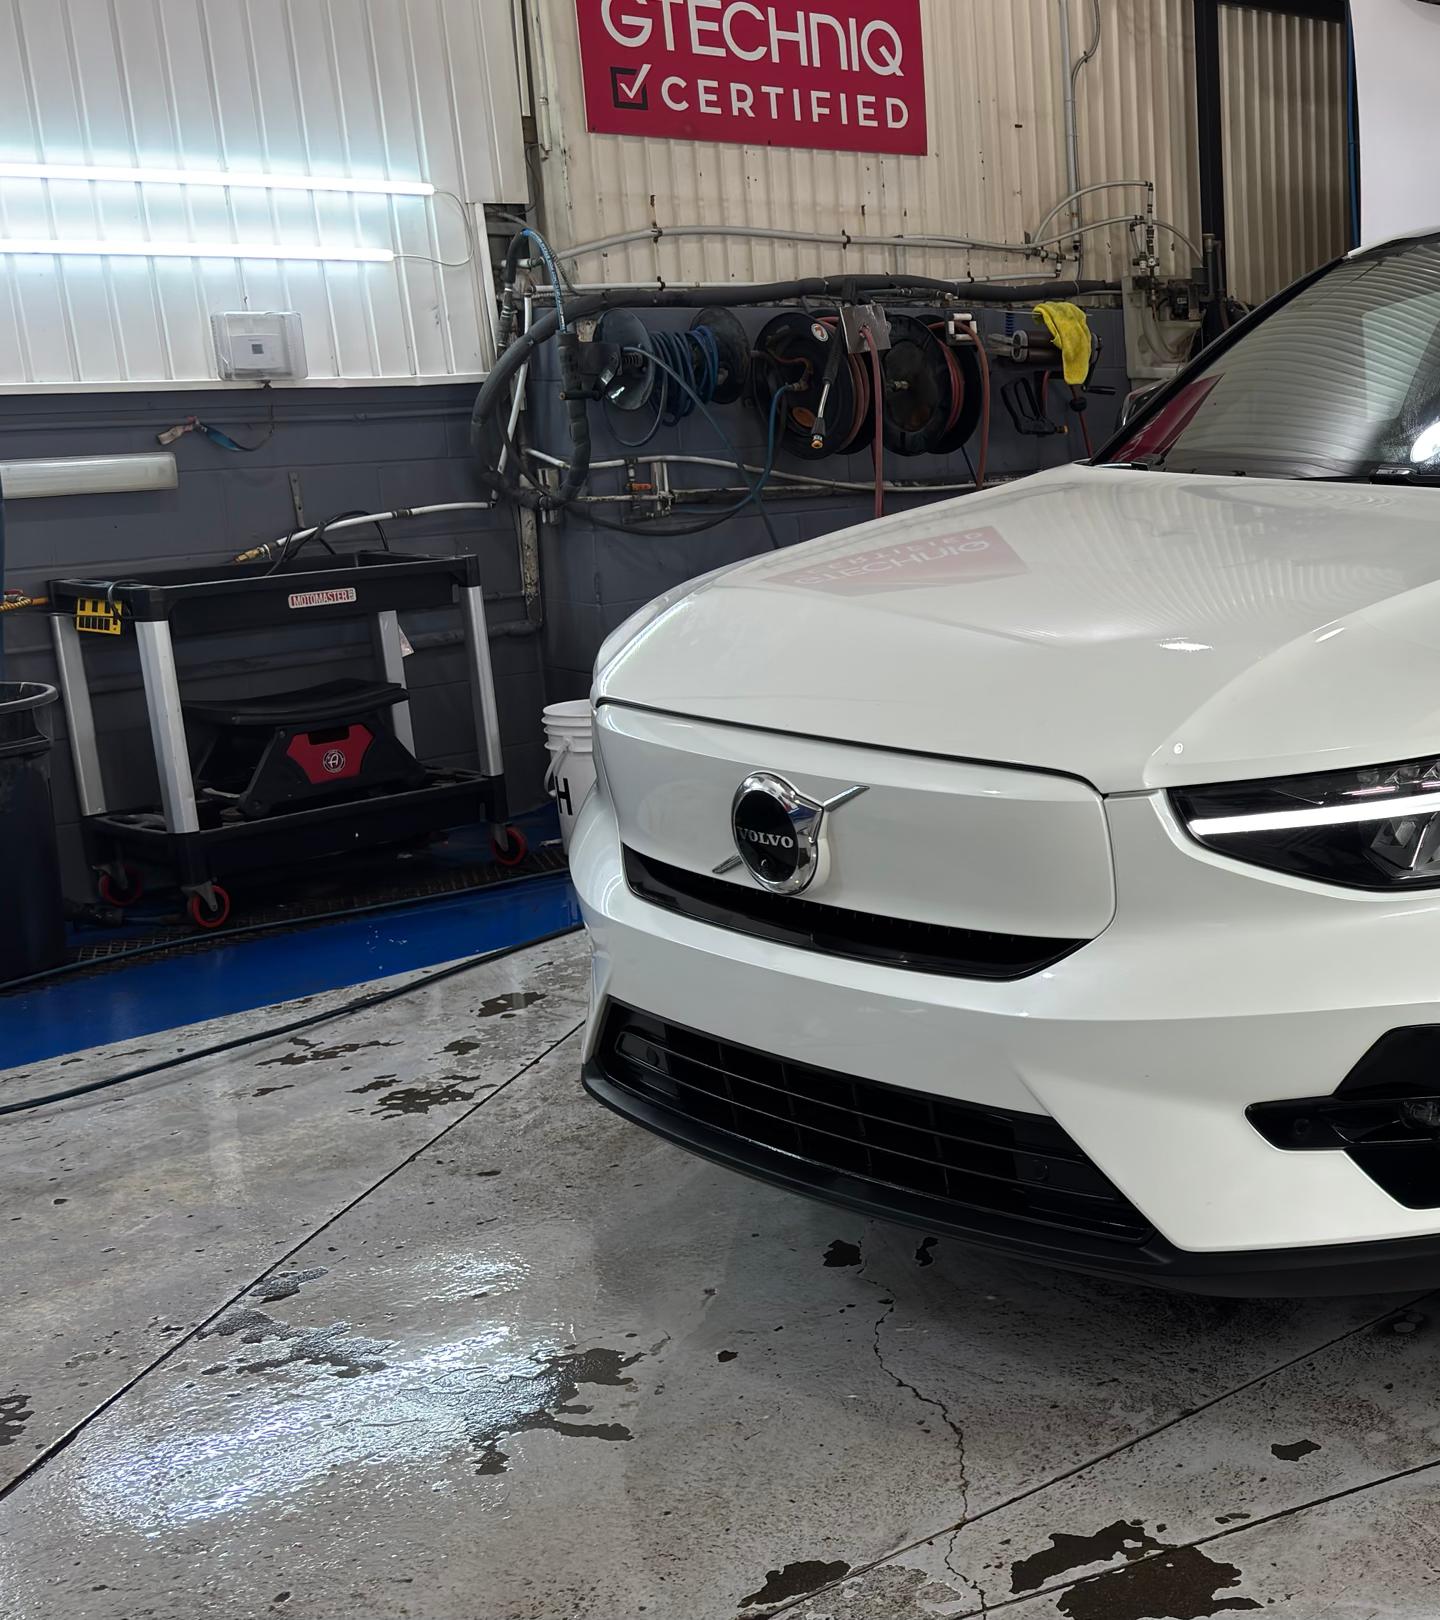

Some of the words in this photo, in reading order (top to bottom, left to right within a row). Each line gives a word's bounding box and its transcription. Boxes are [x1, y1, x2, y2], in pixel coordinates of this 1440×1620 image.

[601, 0, 904, 77] GTECHNIQ
[661, 76, 908, 129] CERTIFIED
[293, 590, 347, 606] MOTOMASTER
[736, 826, 794, 848] VOLVO
